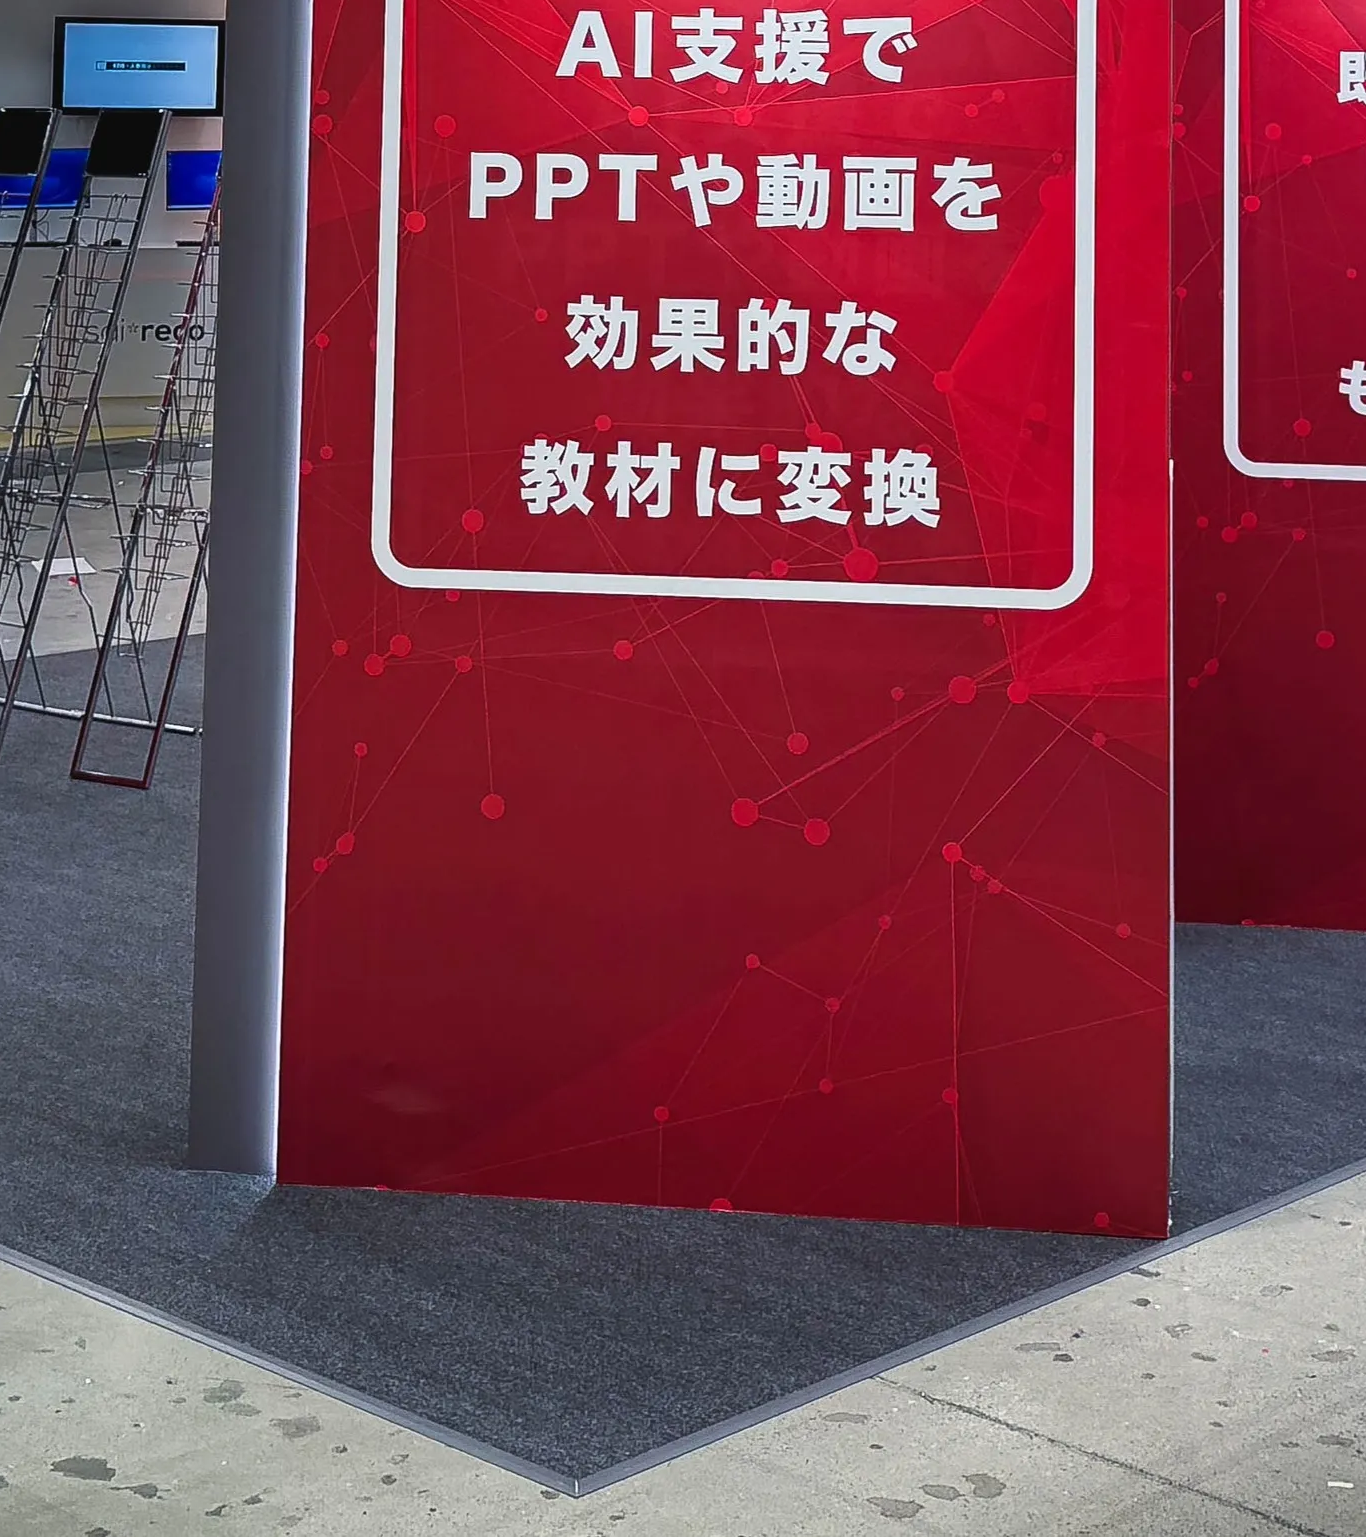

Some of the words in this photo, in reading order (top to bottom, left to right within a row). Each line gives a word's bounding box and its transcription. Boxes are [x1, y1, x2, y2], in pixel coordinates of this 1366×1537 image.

[555, 8, 918, 85] AI支援で
[468, 151, 1002, 232] PPTや動画を
[565, 294, 899, 377] 効果的な
[521, 440, 941, 528] 教材に変換
